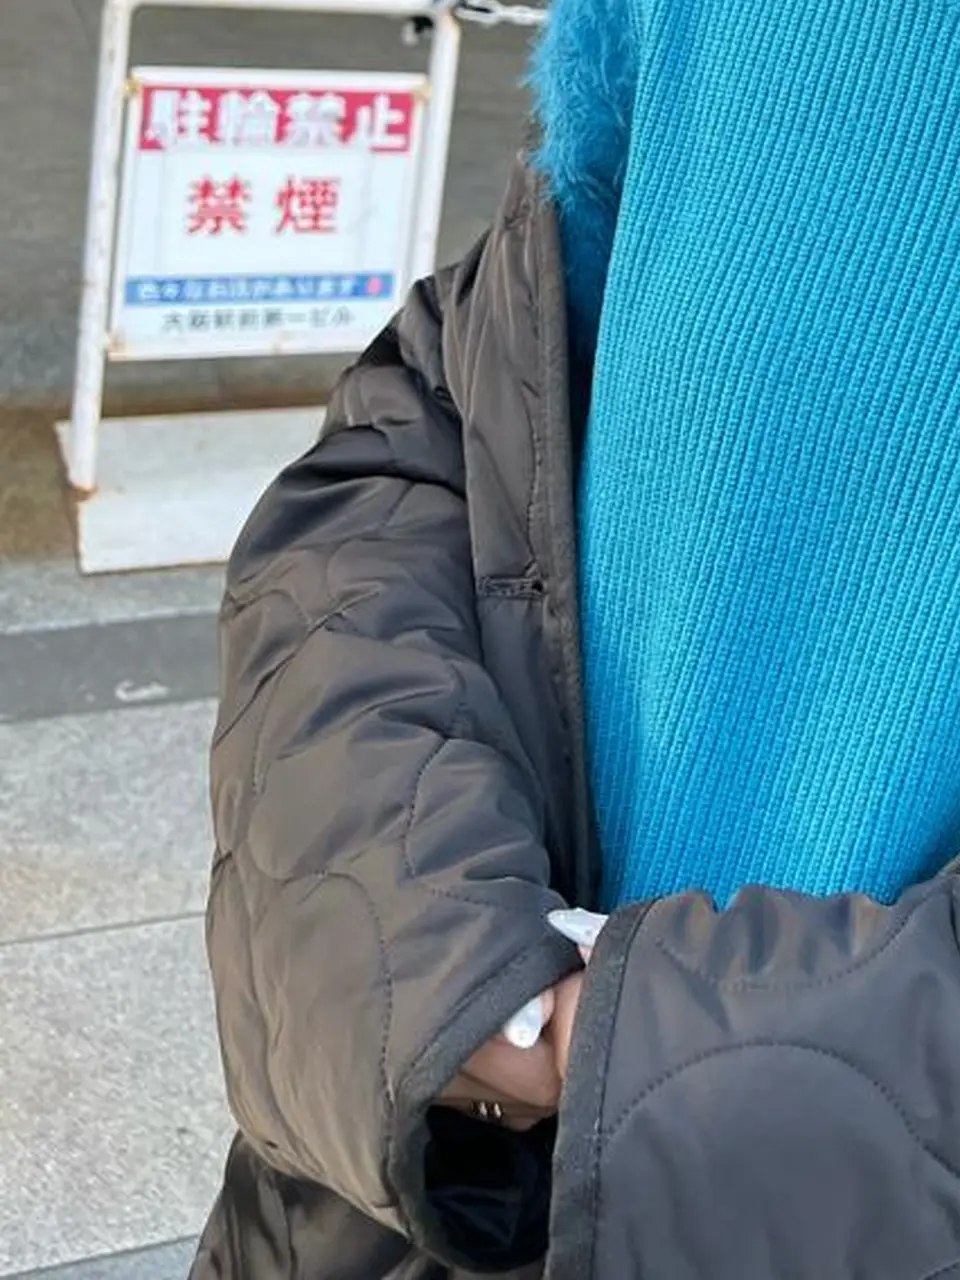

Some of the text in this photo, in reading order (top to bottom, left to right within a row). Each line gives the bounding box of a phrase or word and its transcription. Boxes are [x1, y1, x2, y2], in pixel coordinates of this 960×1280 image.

[143, 89, 407, 149] 駐輪禁止
[187, 173, 341, 235] 禁煙
